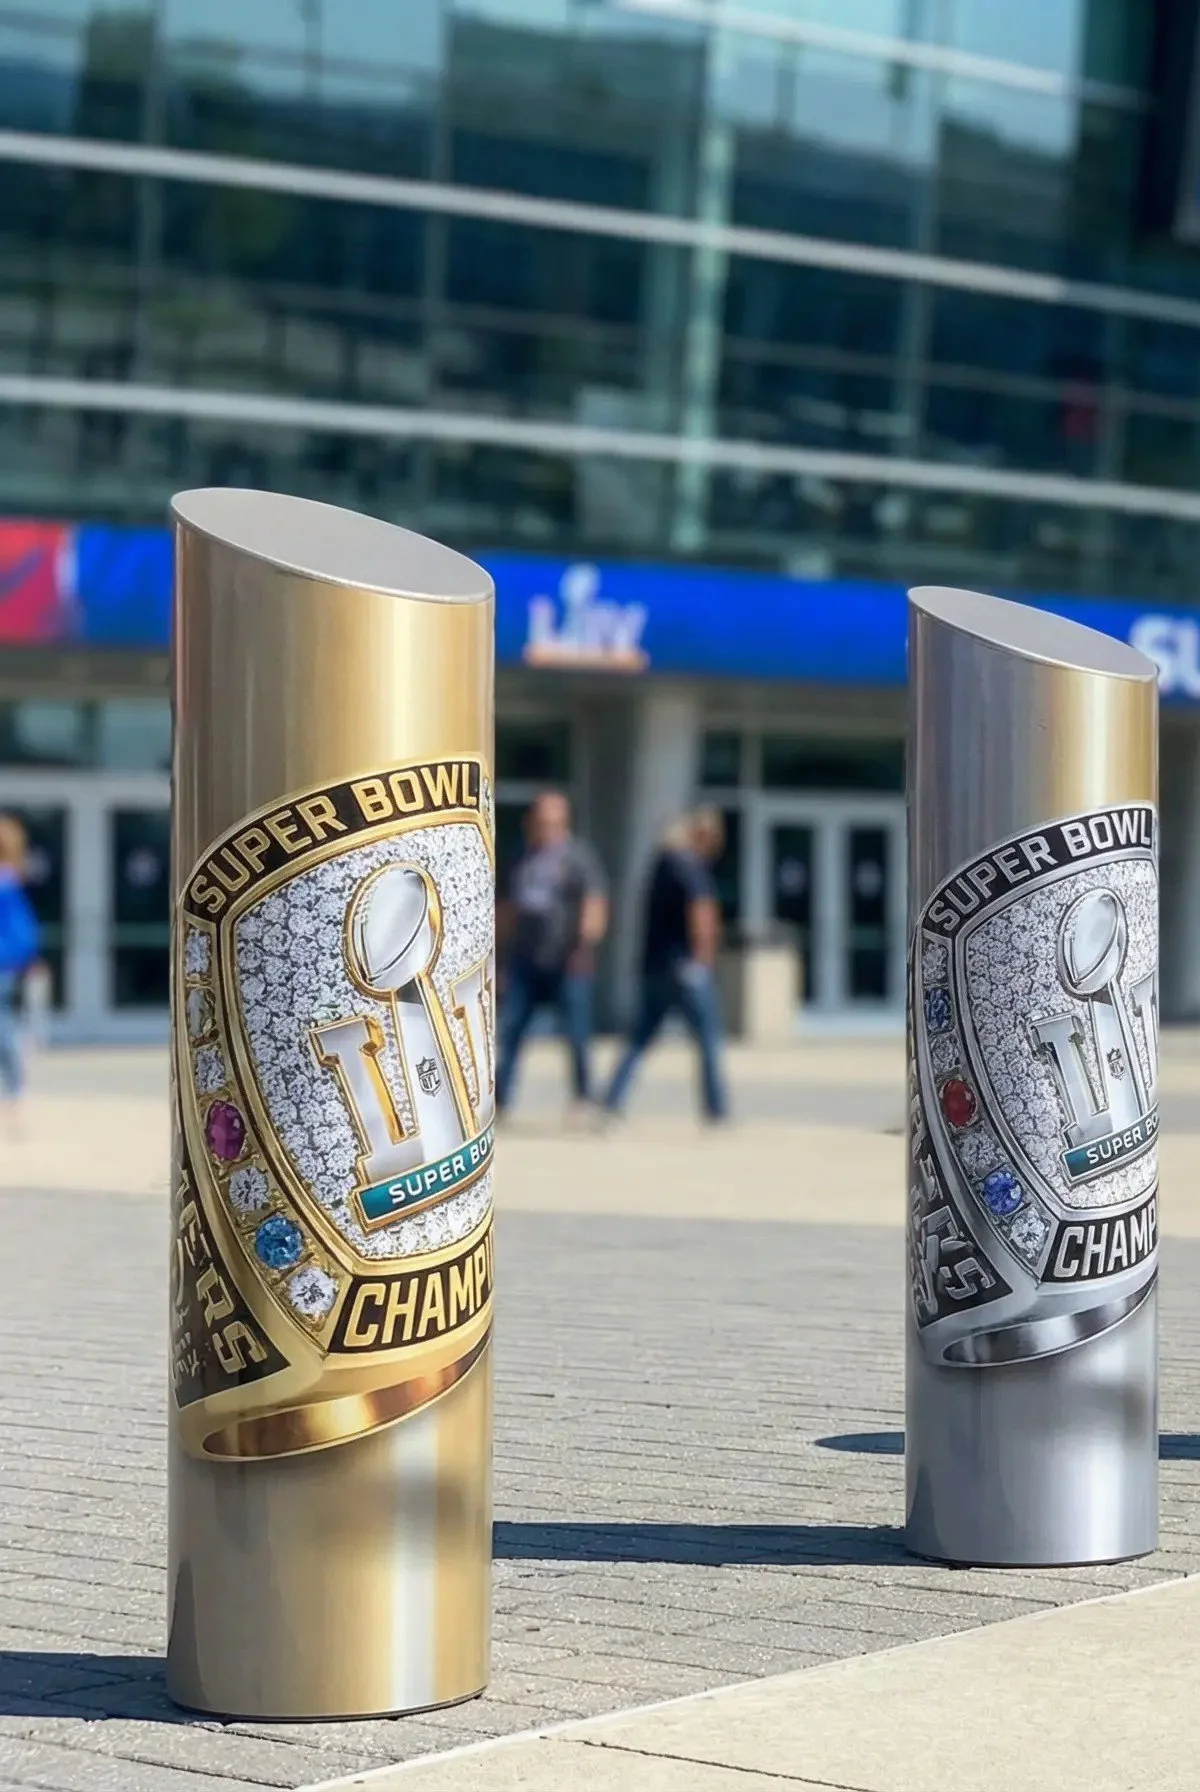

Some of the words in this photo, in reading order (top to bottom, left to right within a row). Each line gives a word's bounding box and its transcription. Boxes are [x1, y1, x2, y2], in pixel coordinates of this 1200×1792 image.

[189, 795, 348, 914] SUPER
[350, 763, 478, 823] BOWL
[928, 836, 1058, 931] SUPER
[1060, 810, 1151, 857] BOWL
[388, 1155, 466, 1205] SUPER
[1086, 1127, 1143, 1166] SUPER
[1052, 1198, 1157, 1278] CHAMP
